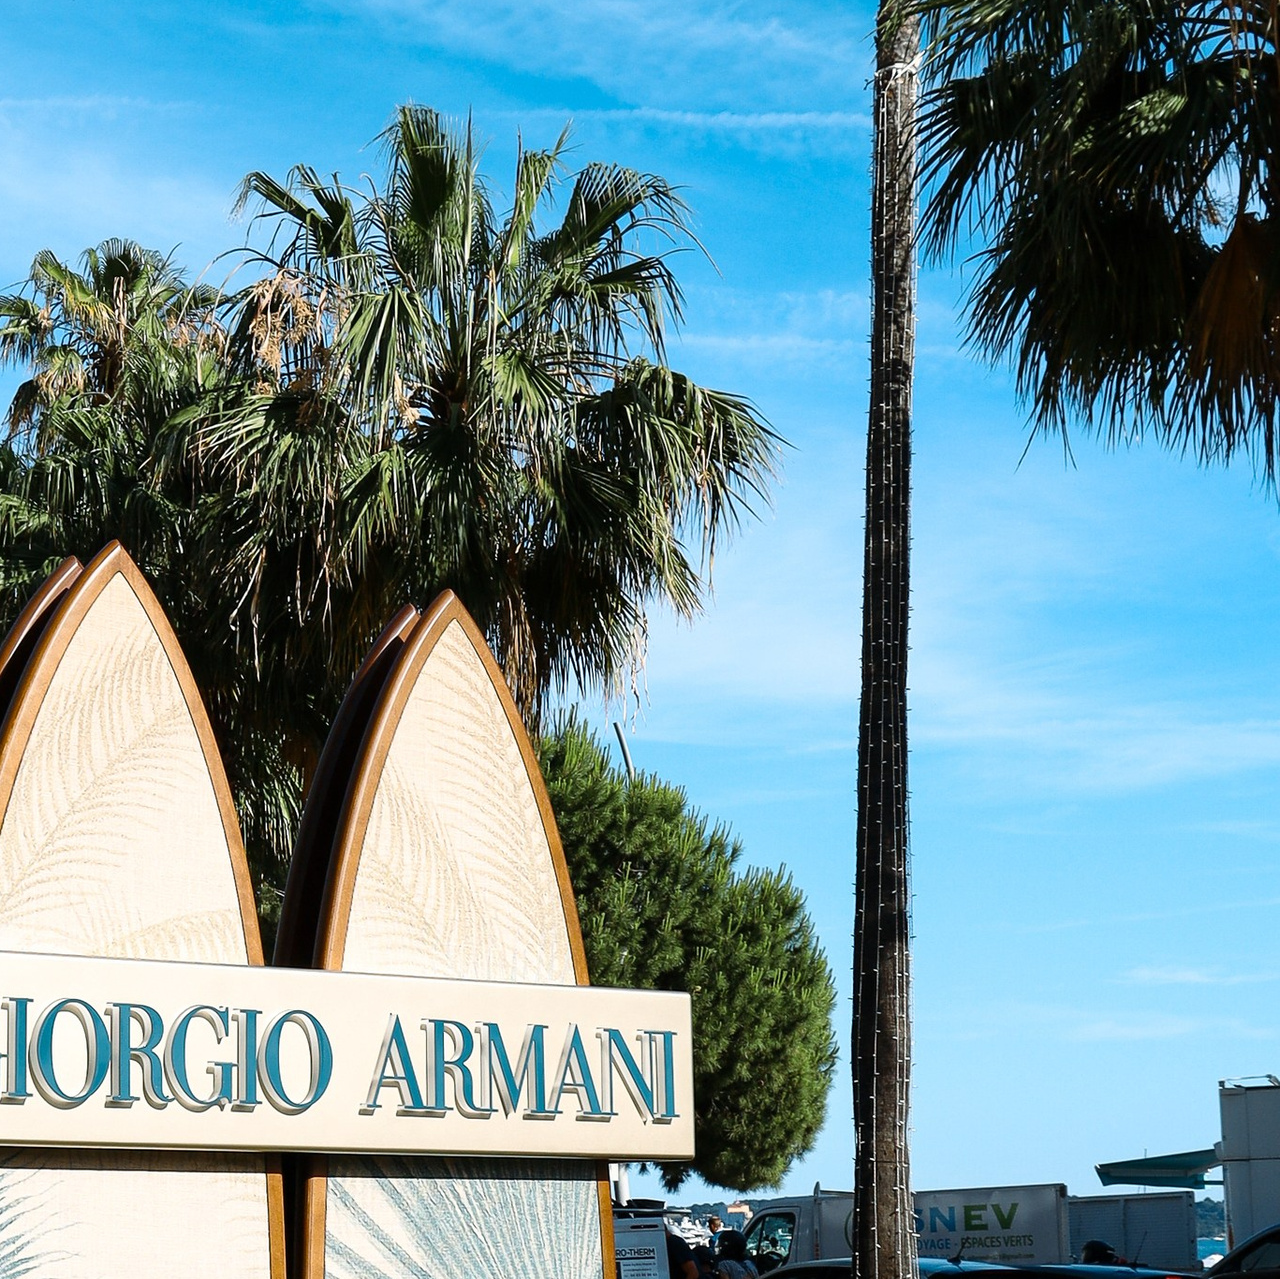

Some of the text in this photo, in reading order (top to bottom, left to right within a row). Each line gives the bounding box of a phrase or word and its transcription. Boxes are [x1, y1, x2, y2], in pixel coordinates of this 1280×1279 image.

[358, 1013, 680, 1125] ARMANI
[961, 1236, 1002, 1249] ESPACES
[1004, 1234, 1034, 1247] VERTS
